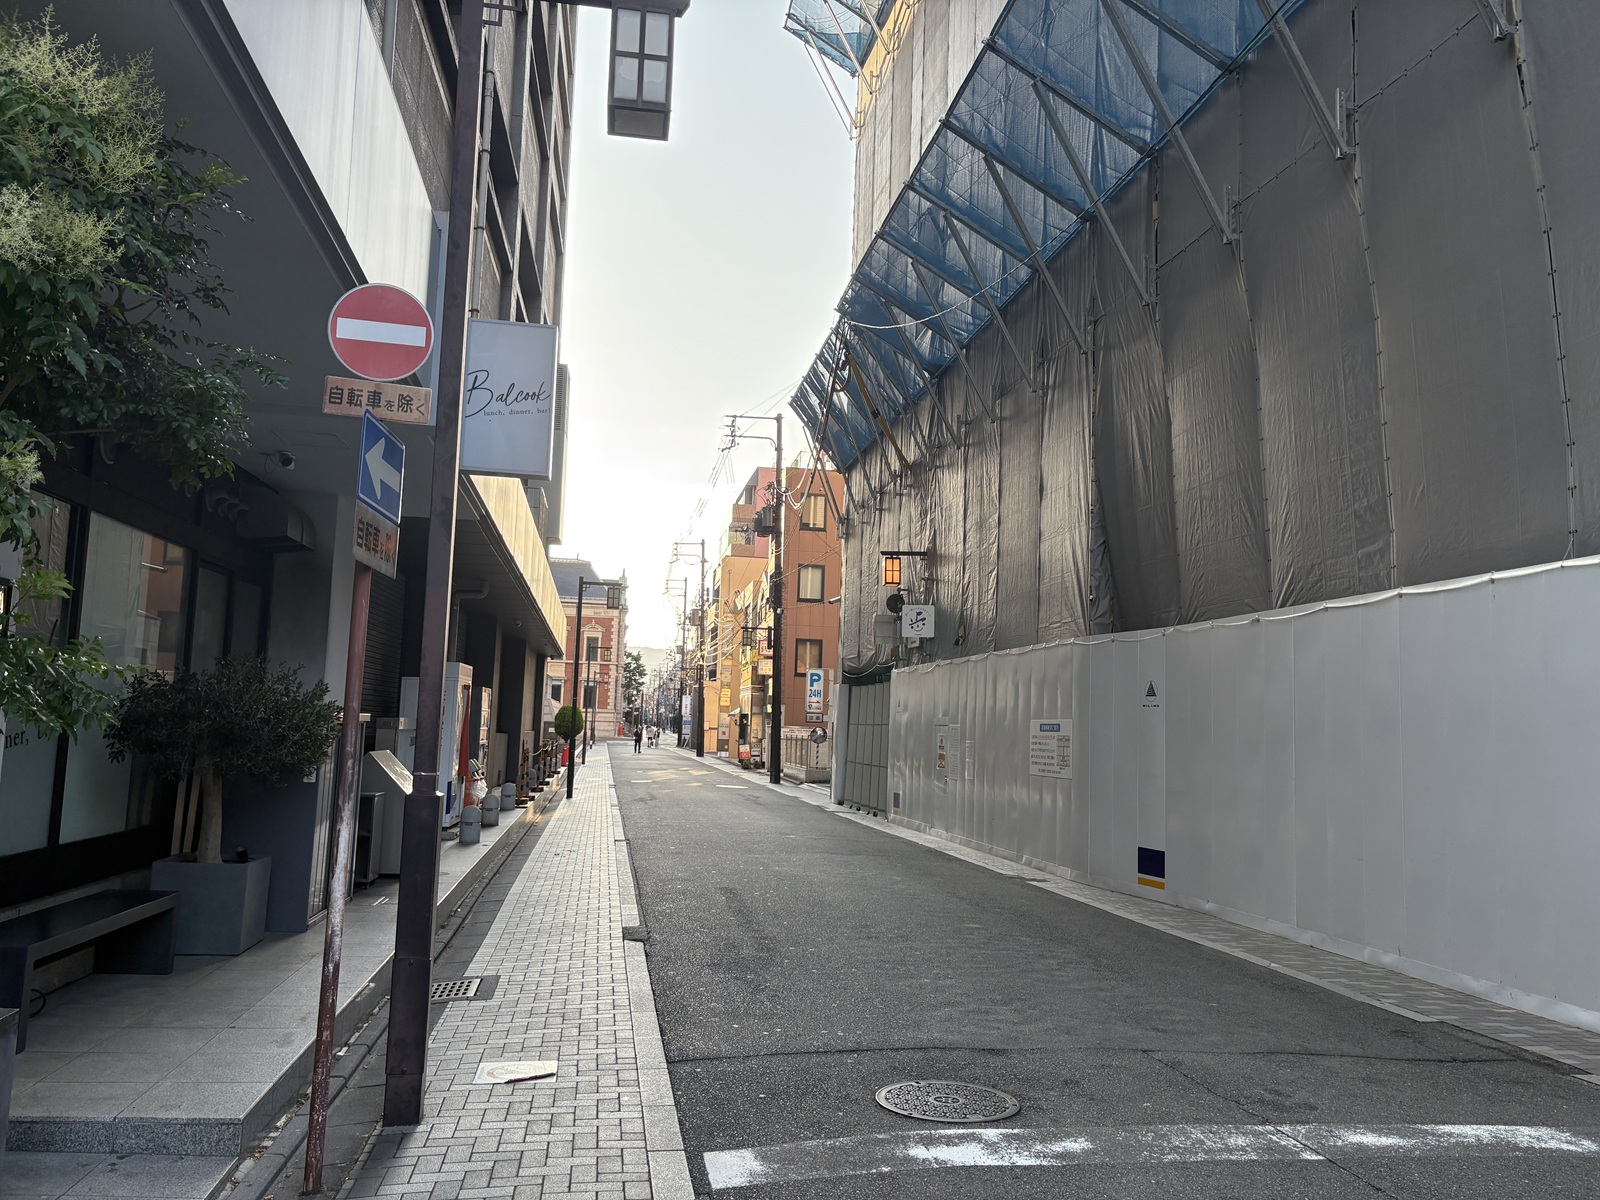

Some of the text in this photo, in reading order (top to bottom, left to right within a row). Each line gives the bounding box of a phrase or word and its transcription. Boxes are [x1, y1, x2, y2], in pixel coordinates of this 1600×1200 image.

[328, 385, 425, 416] 自転車を除く
[465, 369, 551, 418] Balcook
[809, 672, 822, 687] P
[808, 689, 822, 698] 24H
